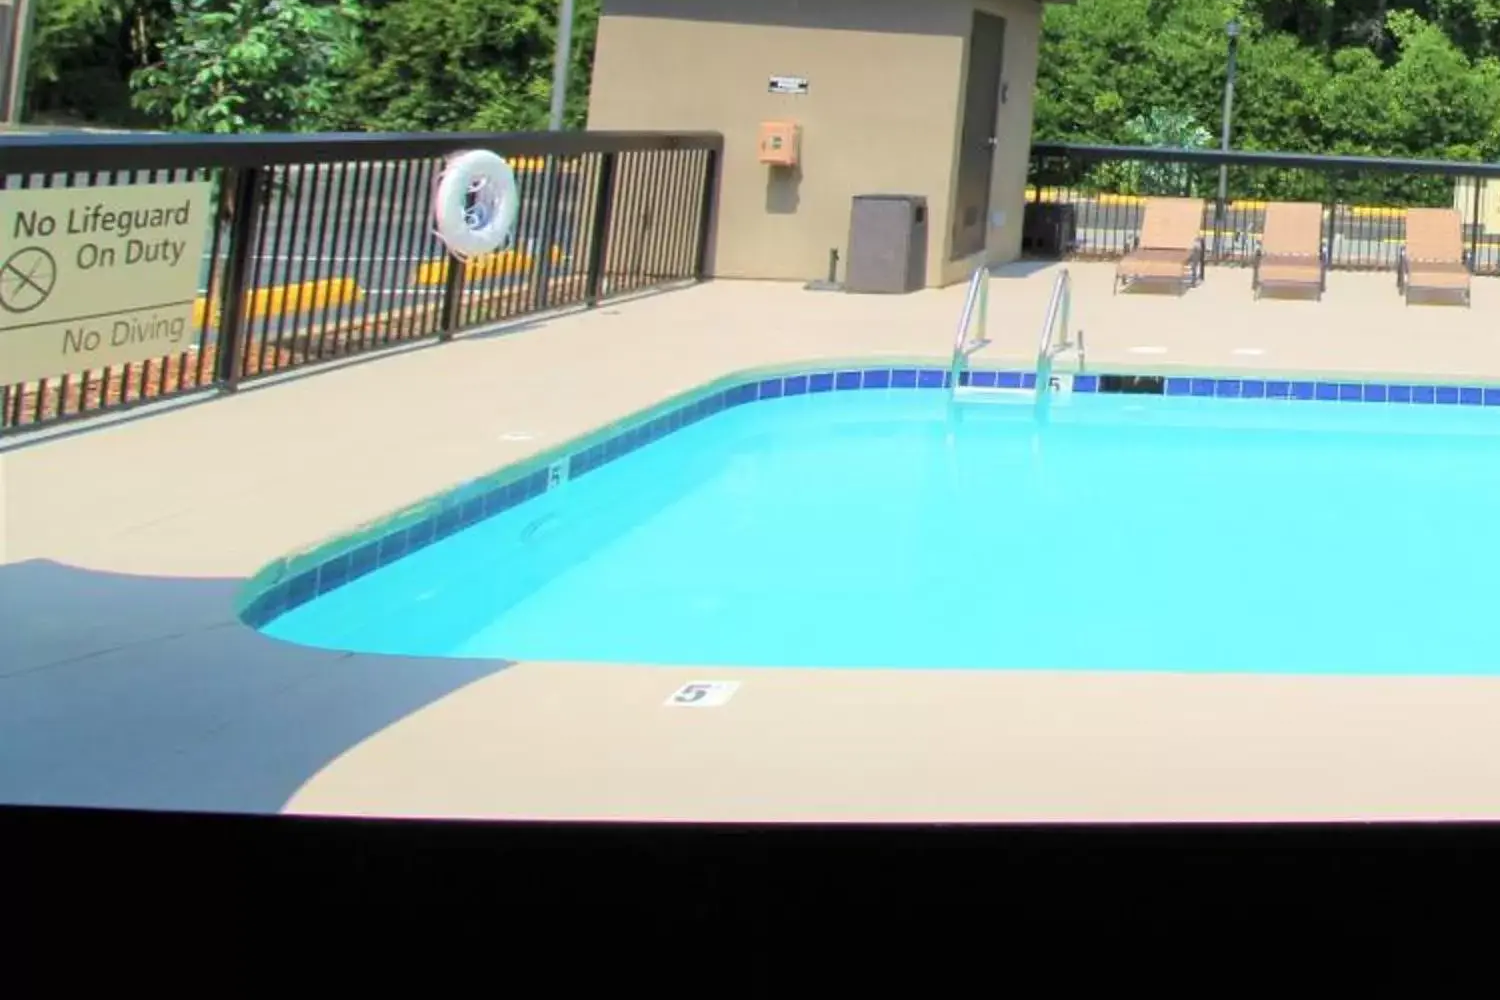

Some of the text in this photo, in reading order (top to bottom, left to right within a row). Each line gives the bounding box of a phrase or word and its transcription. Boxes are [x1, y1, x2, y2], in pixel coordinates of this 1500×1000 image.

[14, 199, 191, 239] No Lifeguard
[76, 239, 186, 270] On Duty
[62, 312, 186, 354] No Diving
[674, 683, 712, 703] 5
